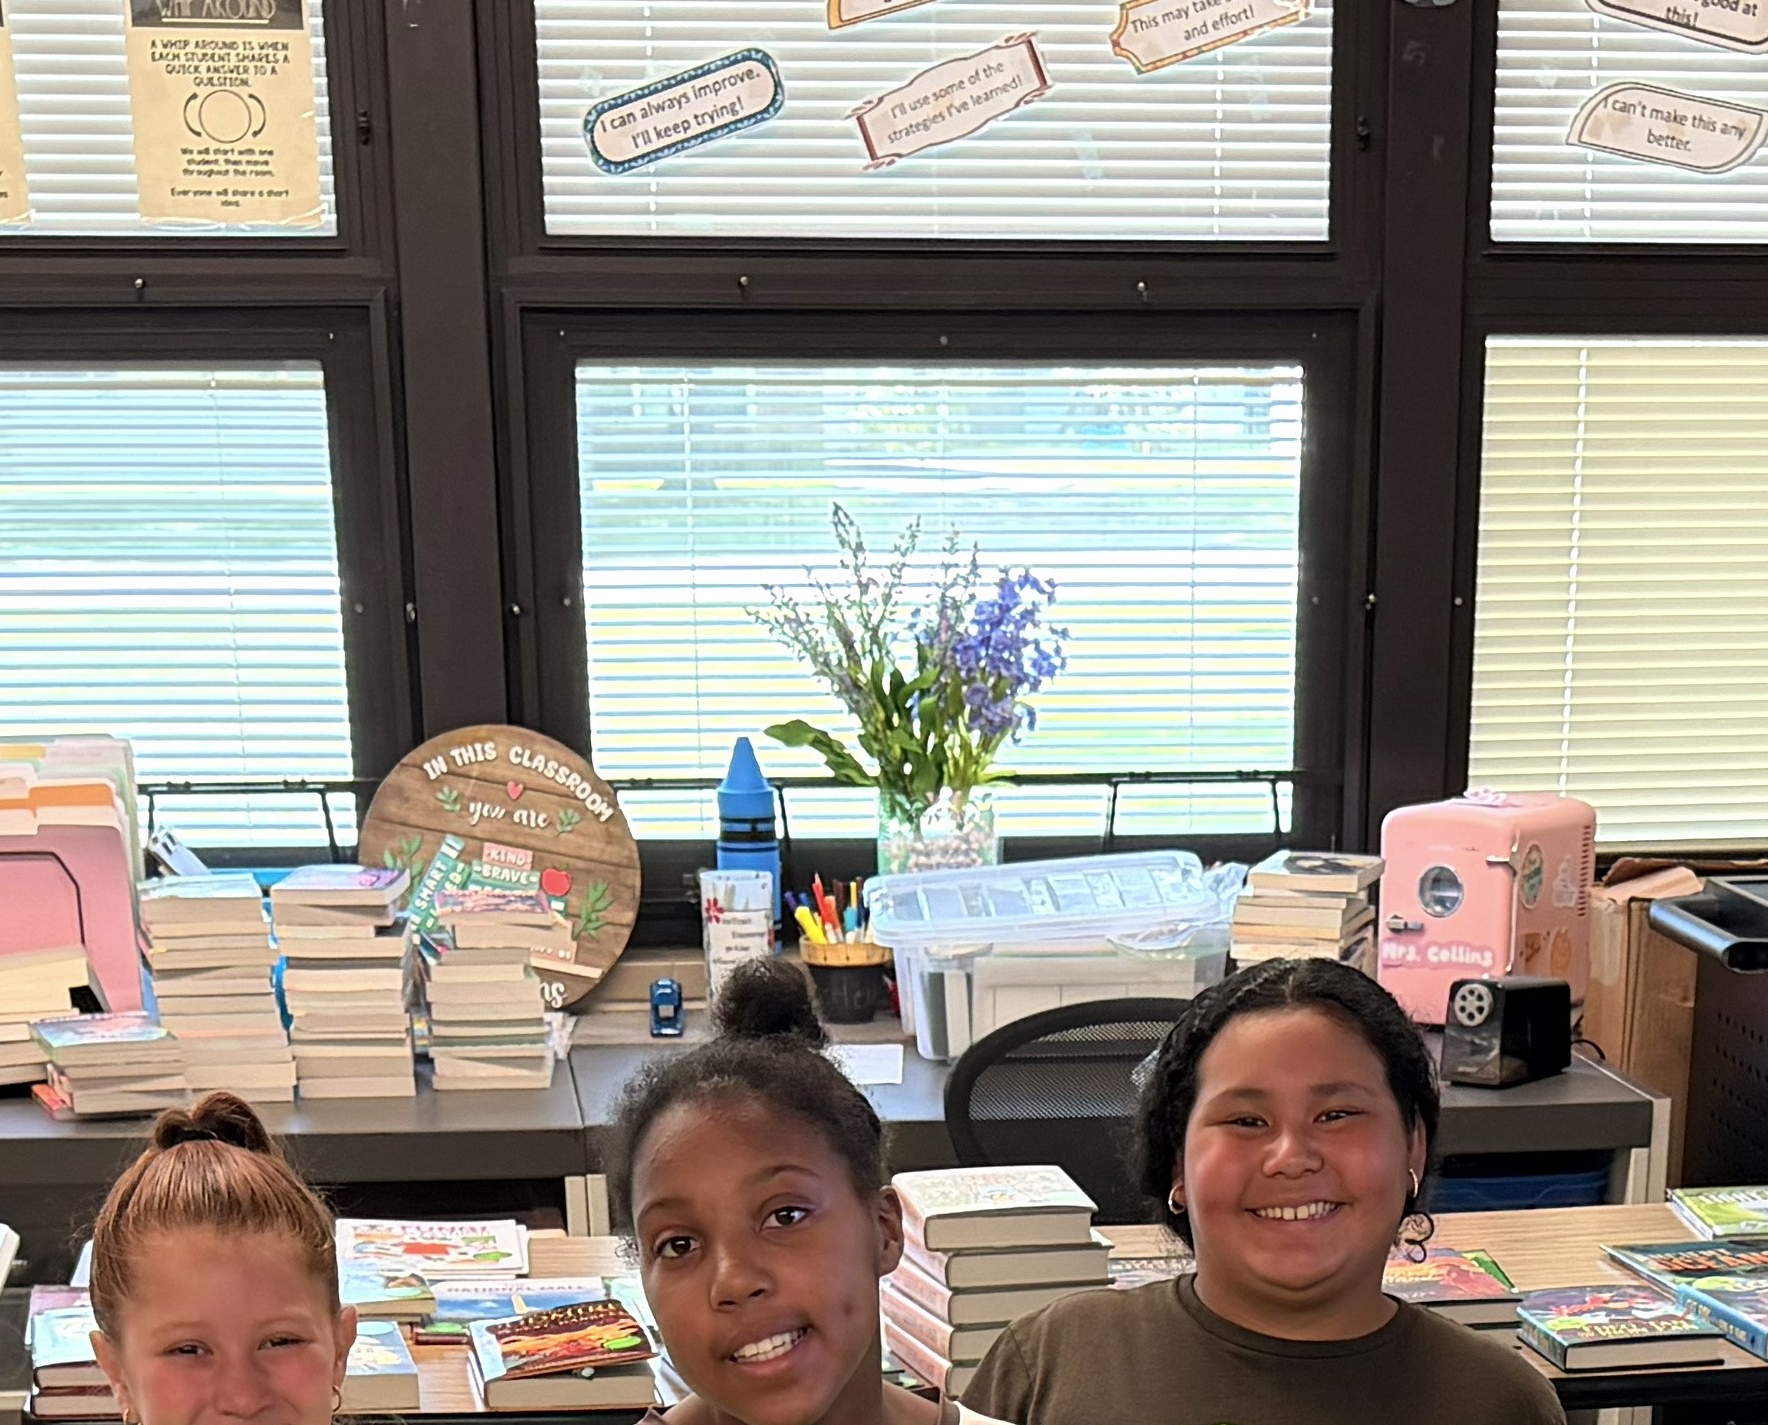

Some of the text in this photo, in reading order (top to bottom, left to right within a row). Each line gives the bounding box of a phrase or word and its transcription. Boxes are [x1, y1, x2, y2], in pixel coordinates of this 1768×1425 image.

[1184, 9, 1257, 43] and effort!
[185, 52, 231, 63] STUDENT
[282, 52, 290, 63] A
[610, 111, 638, 131] can
[640, 91, 691, 124] always
[692, 68, 762, 100] improve.
[887, 75, 1025, 144] strategies I've learned!
[891, 60, 1006, 120] I'll use some of the
[631, 99, 746, 150] I'll keep trying!
[1612, 99, 1644, 118] can't
[1649, 107, 1689, 127] make
[1691, 111, 1717, 132] this
[1719, 121, 1746, 141] any
[1647, 129, 1692, 152] better.
[423, 741, 614, 822] IN THIS CLASSROOM
[469, 801, 550, 828] you are
[415, 860, 448, 910] SMART
[1383, 942, 1493, 967] Mrs. Collins
